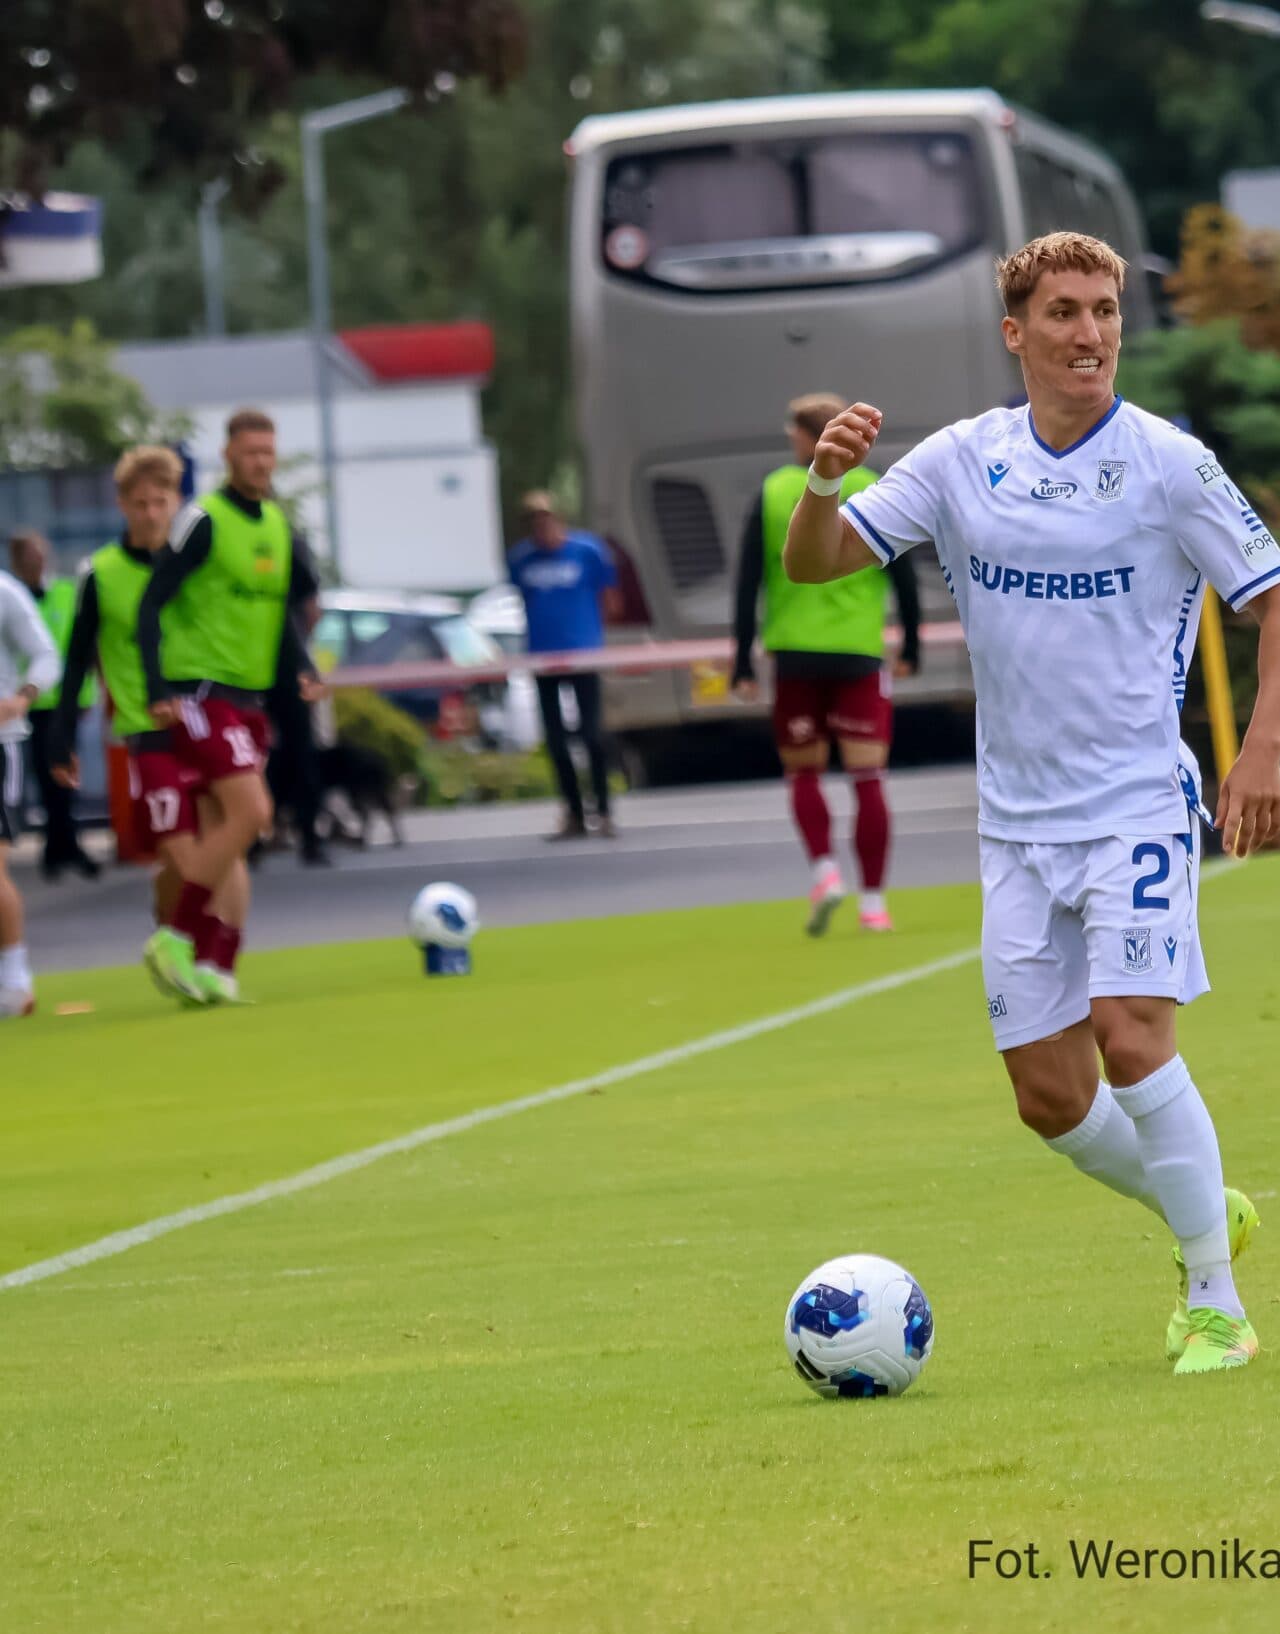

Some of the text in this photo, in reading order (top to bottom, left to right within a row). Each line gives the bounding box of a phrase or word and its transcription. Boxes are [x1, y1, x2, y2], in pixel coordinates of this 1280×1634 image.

[1040, 486, 1069, 496] LOTTO
[970, 555, 1136, 600] SUPERBET
[145, 786, 180, 832] 17
[1131, 842, 1170, 910] 2
